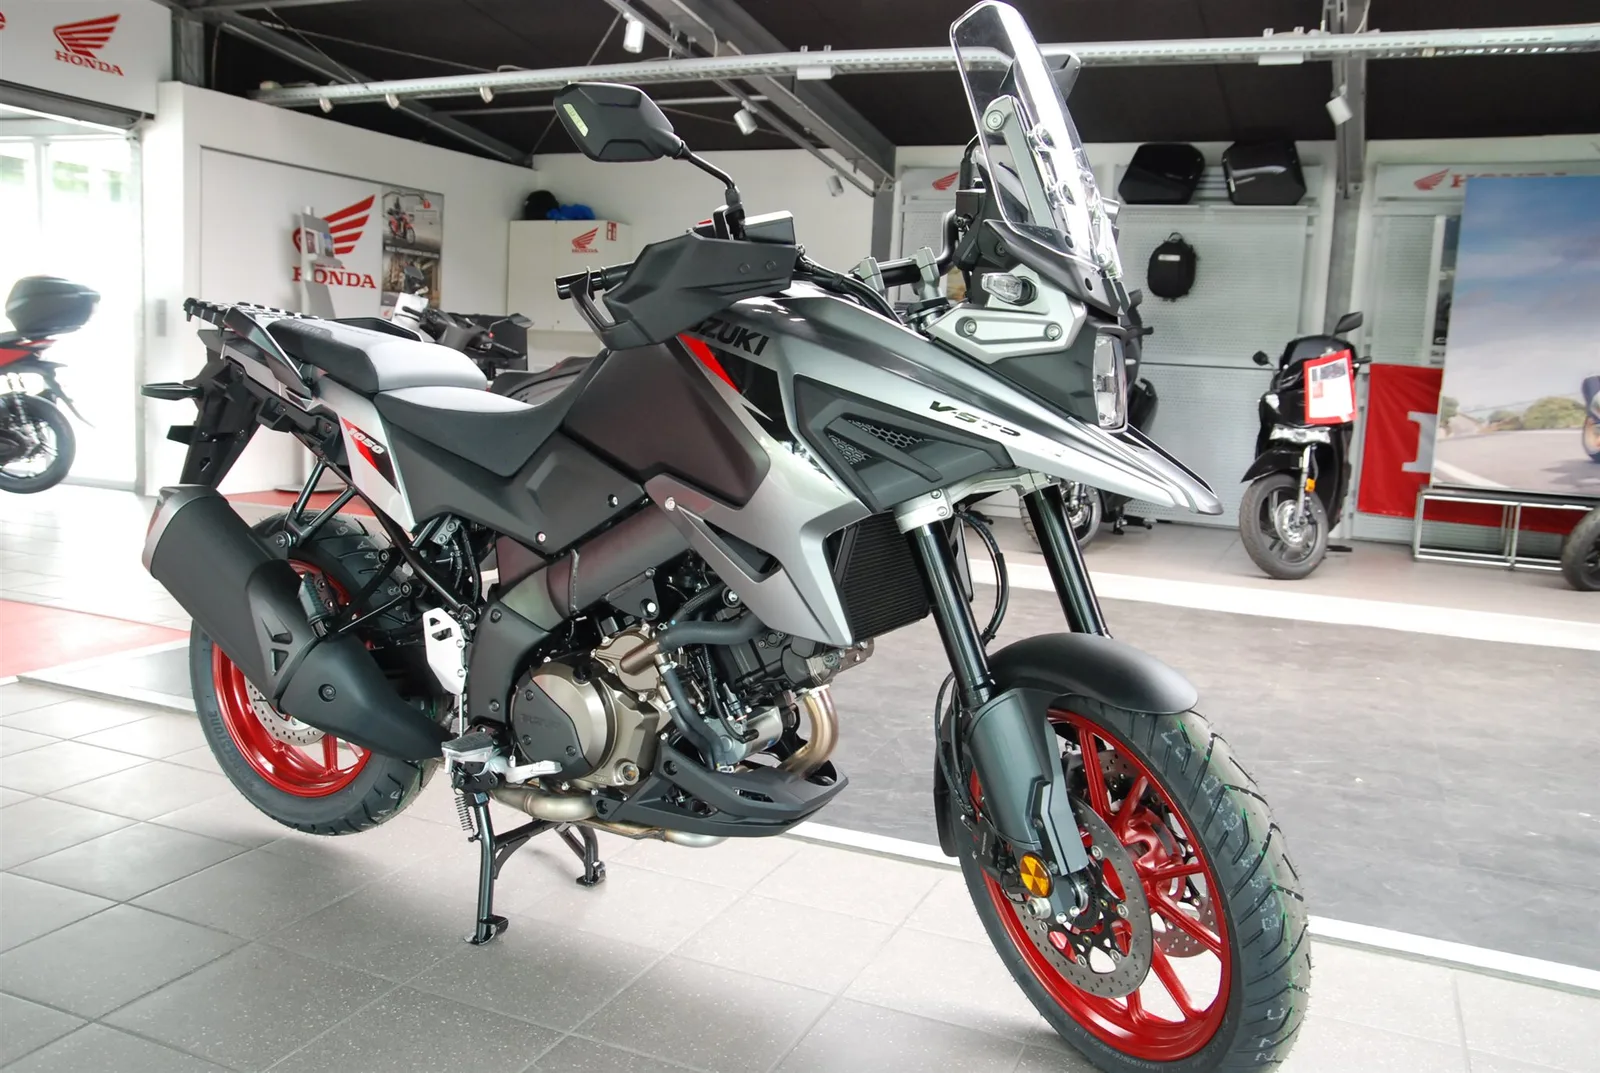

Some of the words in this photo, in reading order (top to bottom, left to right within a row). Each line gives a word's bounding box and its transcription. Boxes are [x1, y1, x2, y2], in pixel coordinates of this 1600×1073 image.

[55, 49, 124, 77] HONDA
[292, 266, 377, 289] HONDA
[689, 317, 770, 356] ZUKI
[348, 428, 385, 455] 1050
